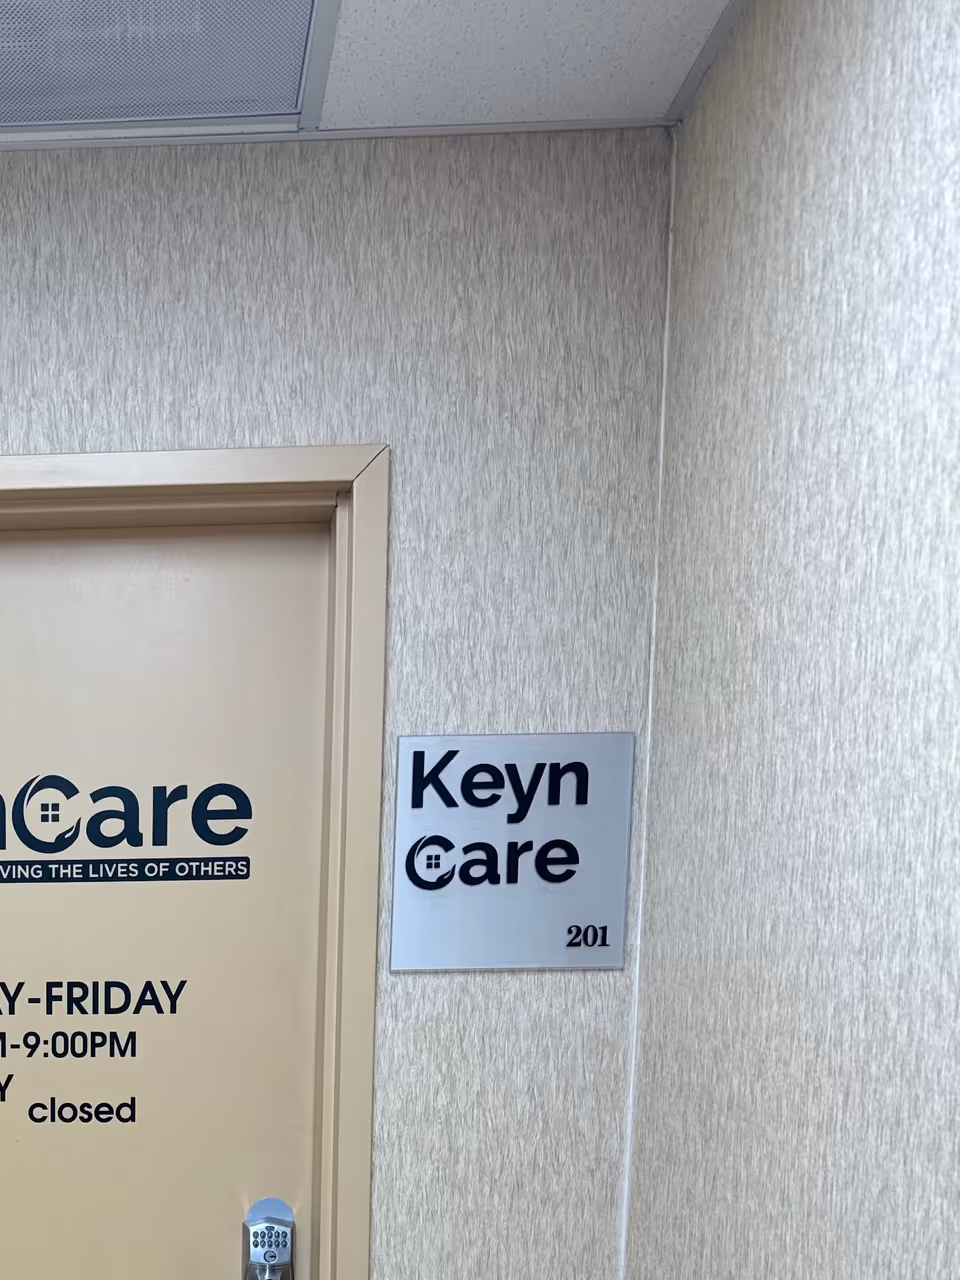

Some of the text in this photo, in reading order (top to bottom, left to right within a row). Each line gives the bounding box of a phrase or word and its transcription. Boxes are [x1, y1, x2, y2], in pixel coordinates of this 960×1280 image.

[411, 750, 589, 824] Keyn
[48, 864, 83, 879] THE
[89, 863, 139, 878] LIVES
[144, 862, 170, 877] OF
[175, 861, 247, 876] OTHERS
[405, 834, 580, 891] Care
[566, 924, 610, 947] 201
[27, 1097, 137, 1124] closed
